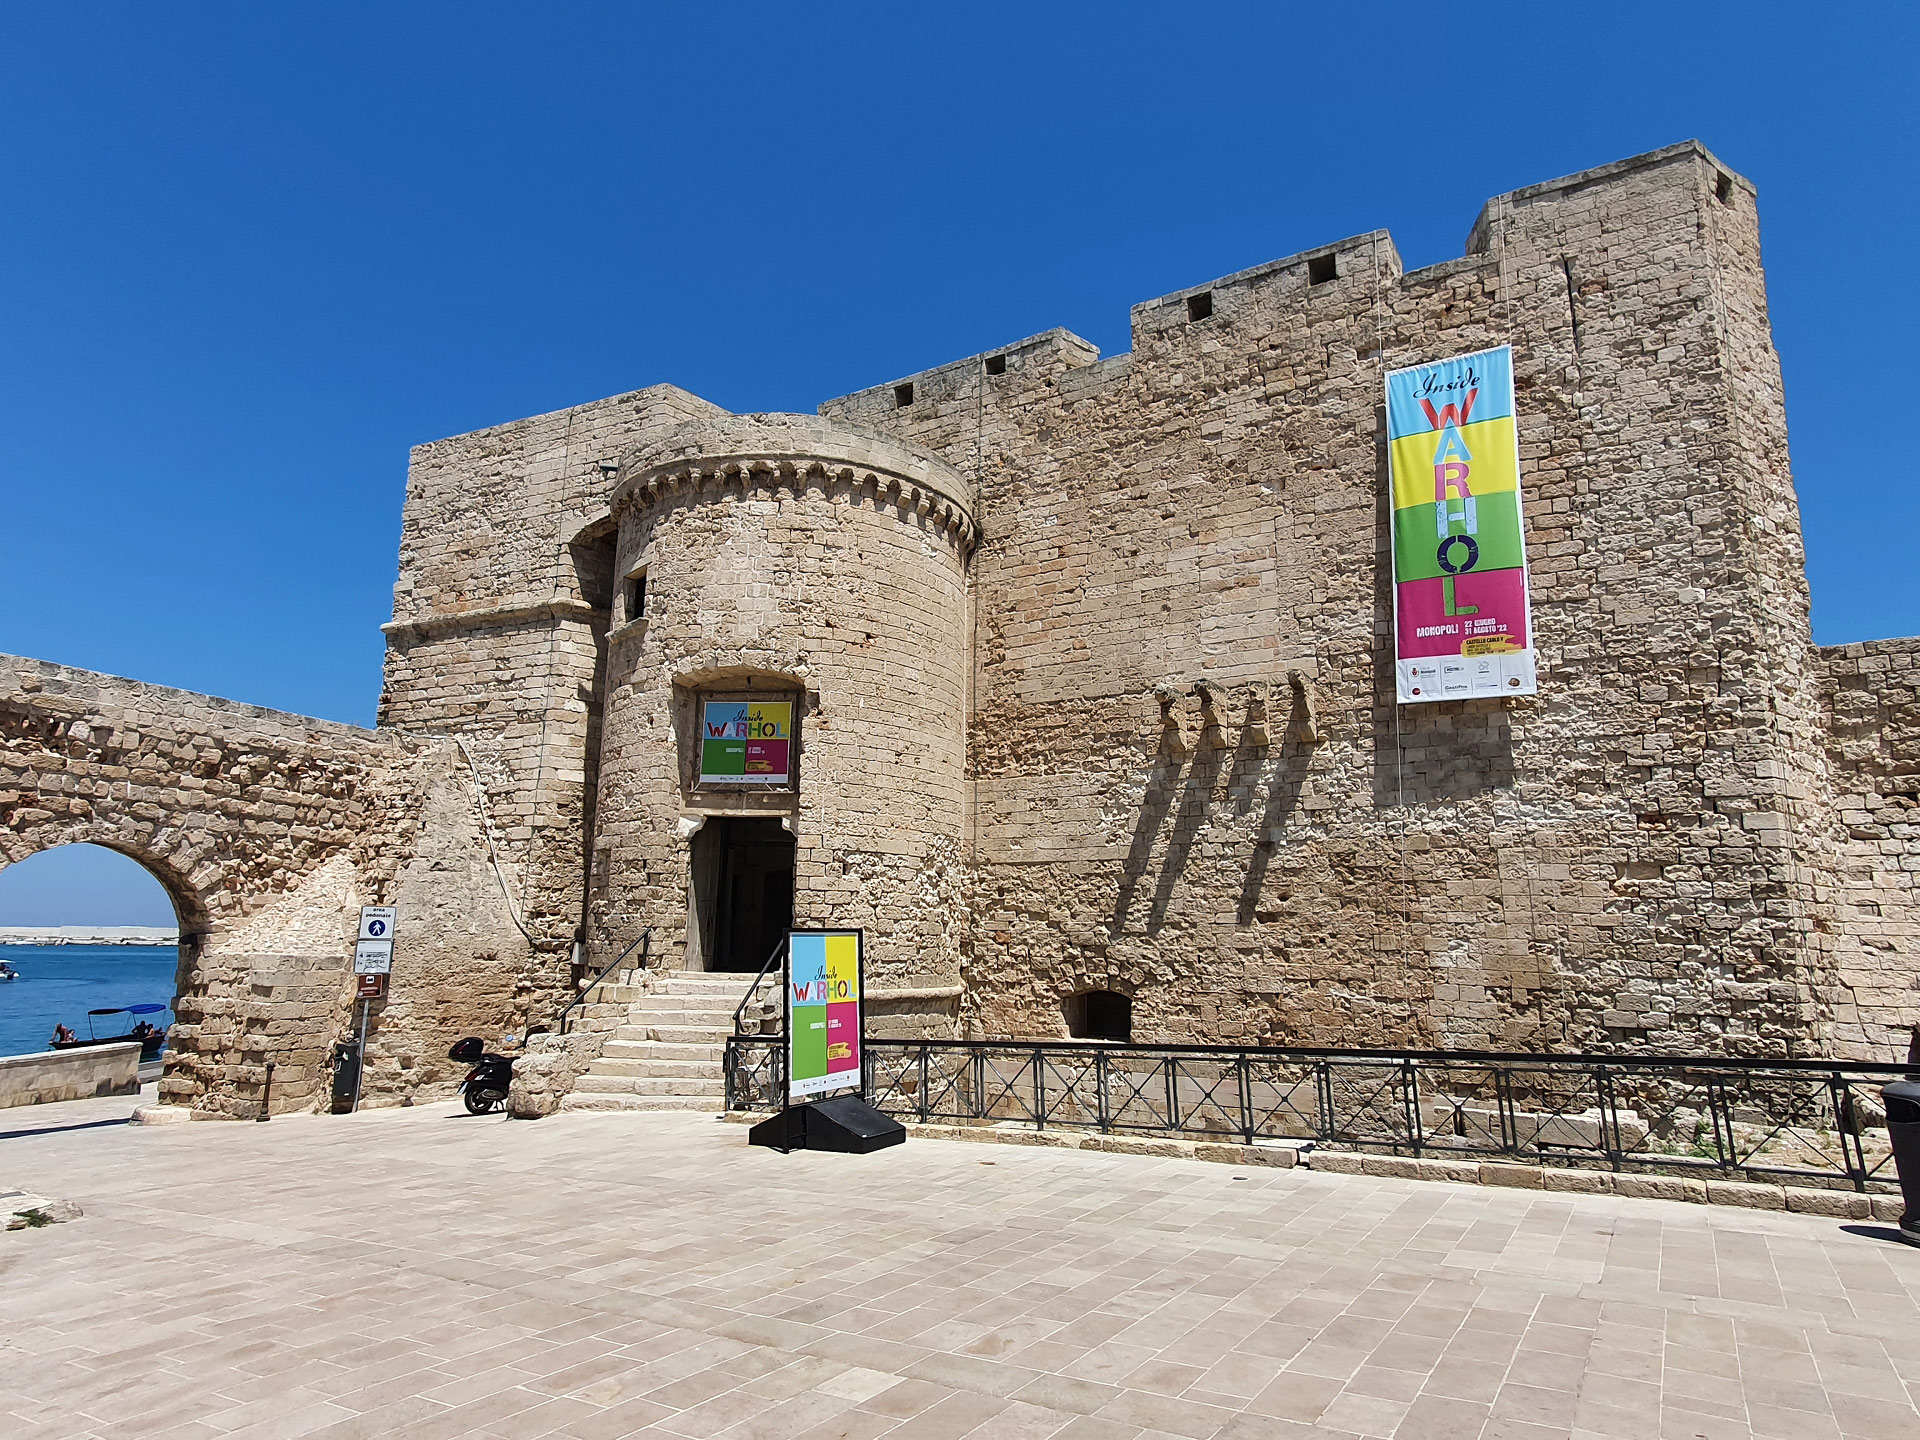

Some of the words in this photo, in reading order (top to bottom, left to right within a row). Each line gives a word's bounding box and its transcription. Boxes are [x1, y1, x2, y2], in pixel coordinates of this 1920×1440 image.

[1413, 367, 1480, 398] Inside
[1419, 387, 1480, 617] WARHOL
[1416, 624, 1459, 638] MONOPOLI
[1464, 620, 1473, 628] 22
[1464, 627, 1472, 635] 31
[1473, 625, 1497, 634] AGOSTO
[733, 709, 763, 721] Inside
[707, 722, 787, 738] WARHOL
[814, 965, 837, 981] Inside
[793, 980, 856, 1001] WARHOL
